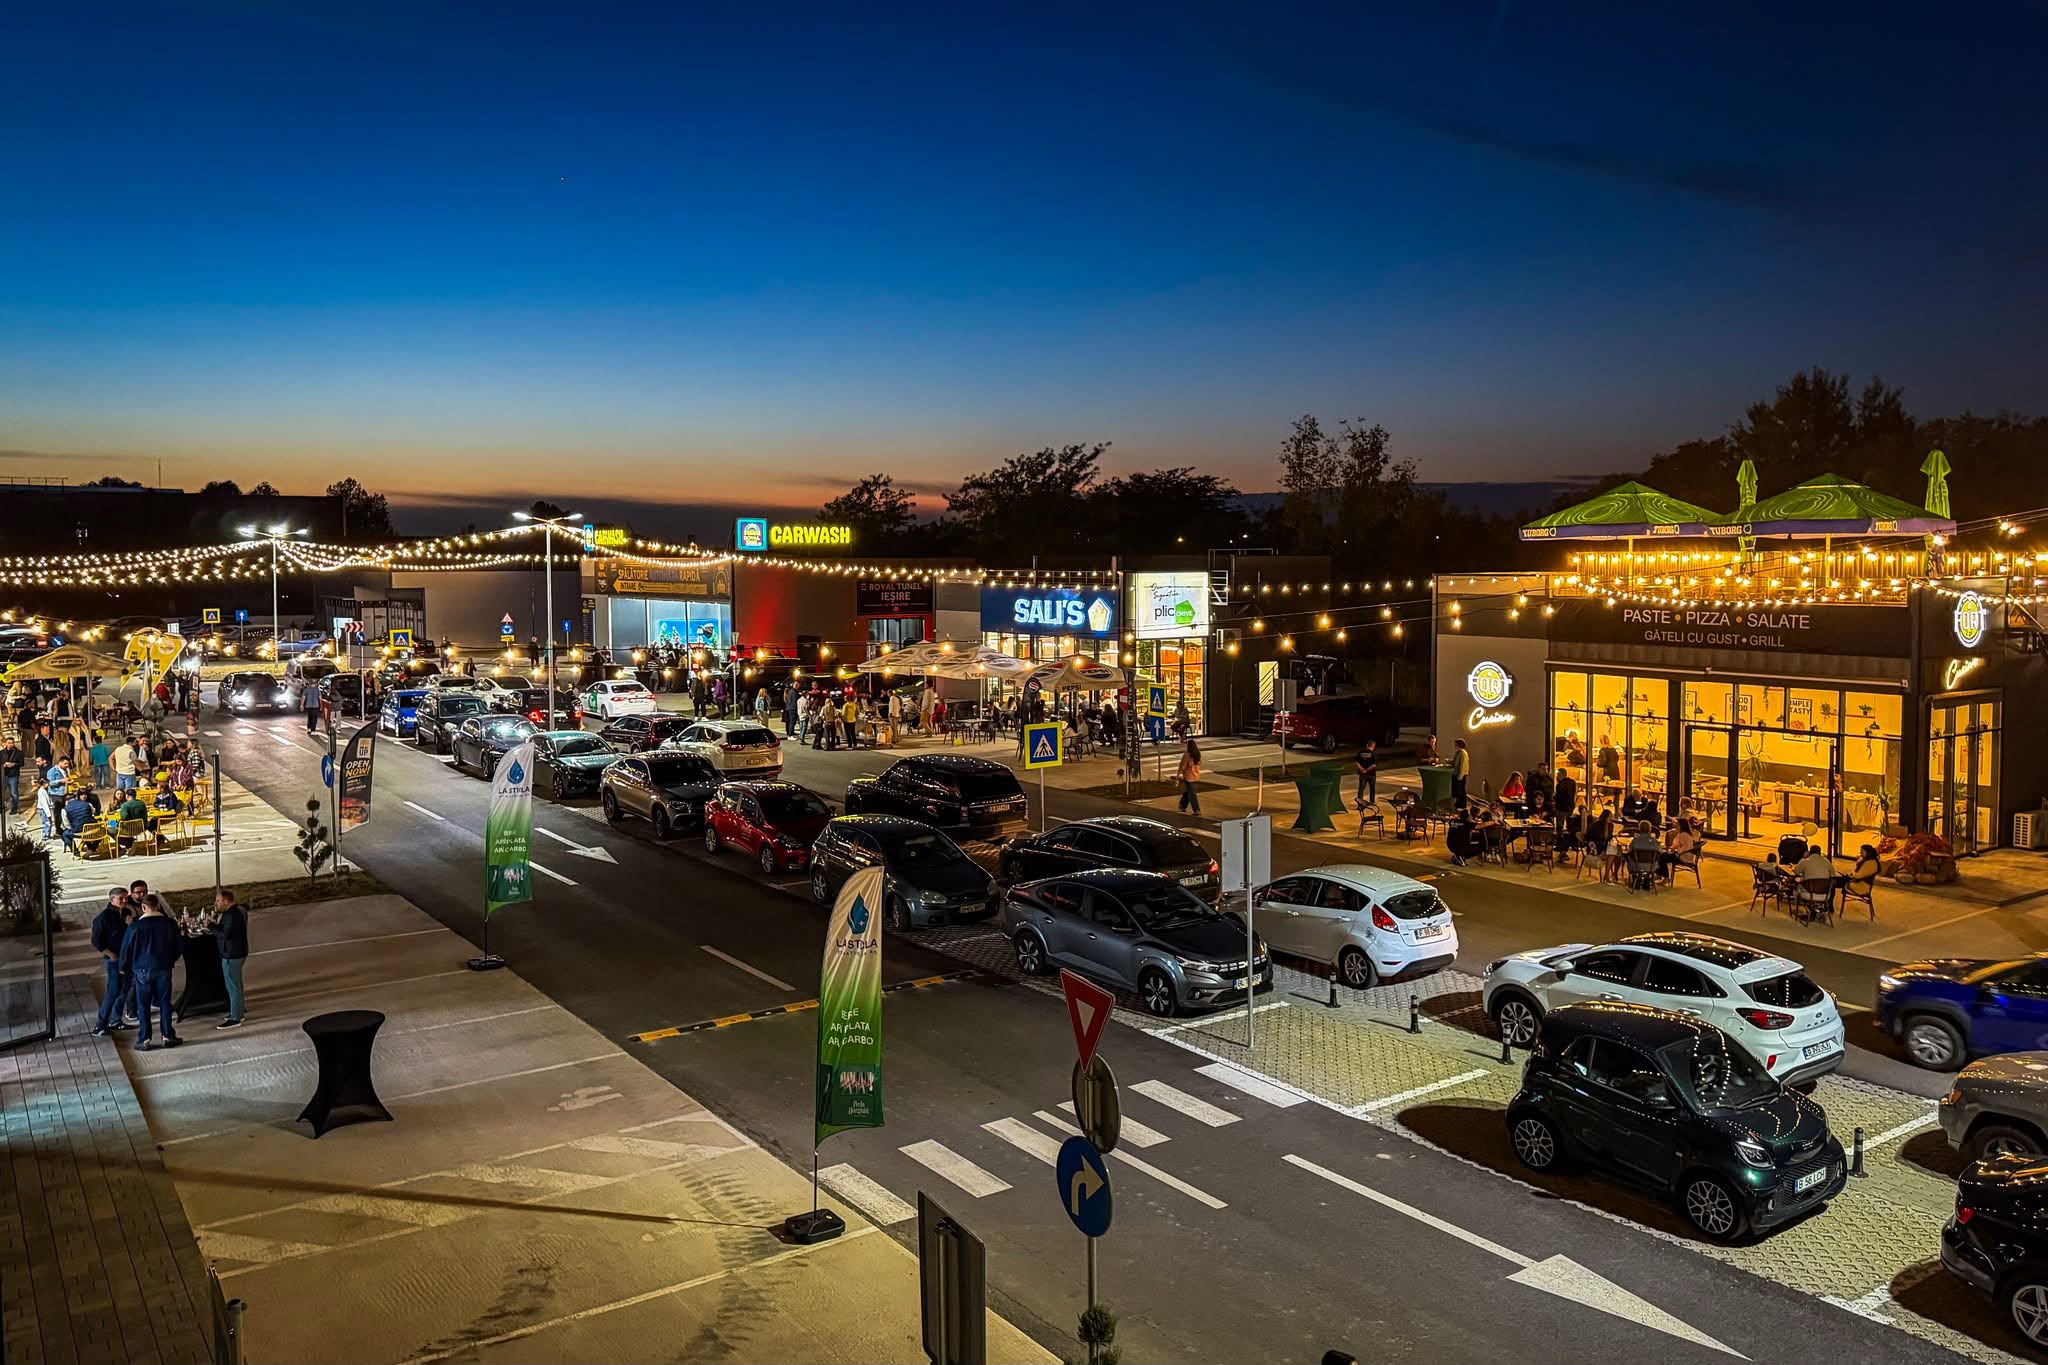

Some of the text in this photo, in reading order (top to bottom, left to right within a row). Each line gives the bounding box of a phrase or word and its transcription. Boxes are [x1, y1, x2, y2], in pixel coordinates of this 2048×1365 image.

[770, 526, 851, 544] CARWASH
[1522, 528, 1549, 537] TUBORG
[1710, 526, 1742, 535] TUBORG
[869, 582, 923, 591] ROYAL TUNEL
[1014, 598, 1086, 626] SALI'S
[1154, 604, 1175, 621] plic
[1623, 609, 1811, 629] PASTE PIZZA SALATE
[1687, 632, 1704, 643] CU
[1706, 633, 1740, 645] GUST
[1749, 635, 1785, 647] GRILL
[1062, 684, 1082, 692] PEPSI
[1468, 674, 1513, 697] FORT
[345, 765, 371, 778] NOW!
[346, 760, 370, 770] OPEN
